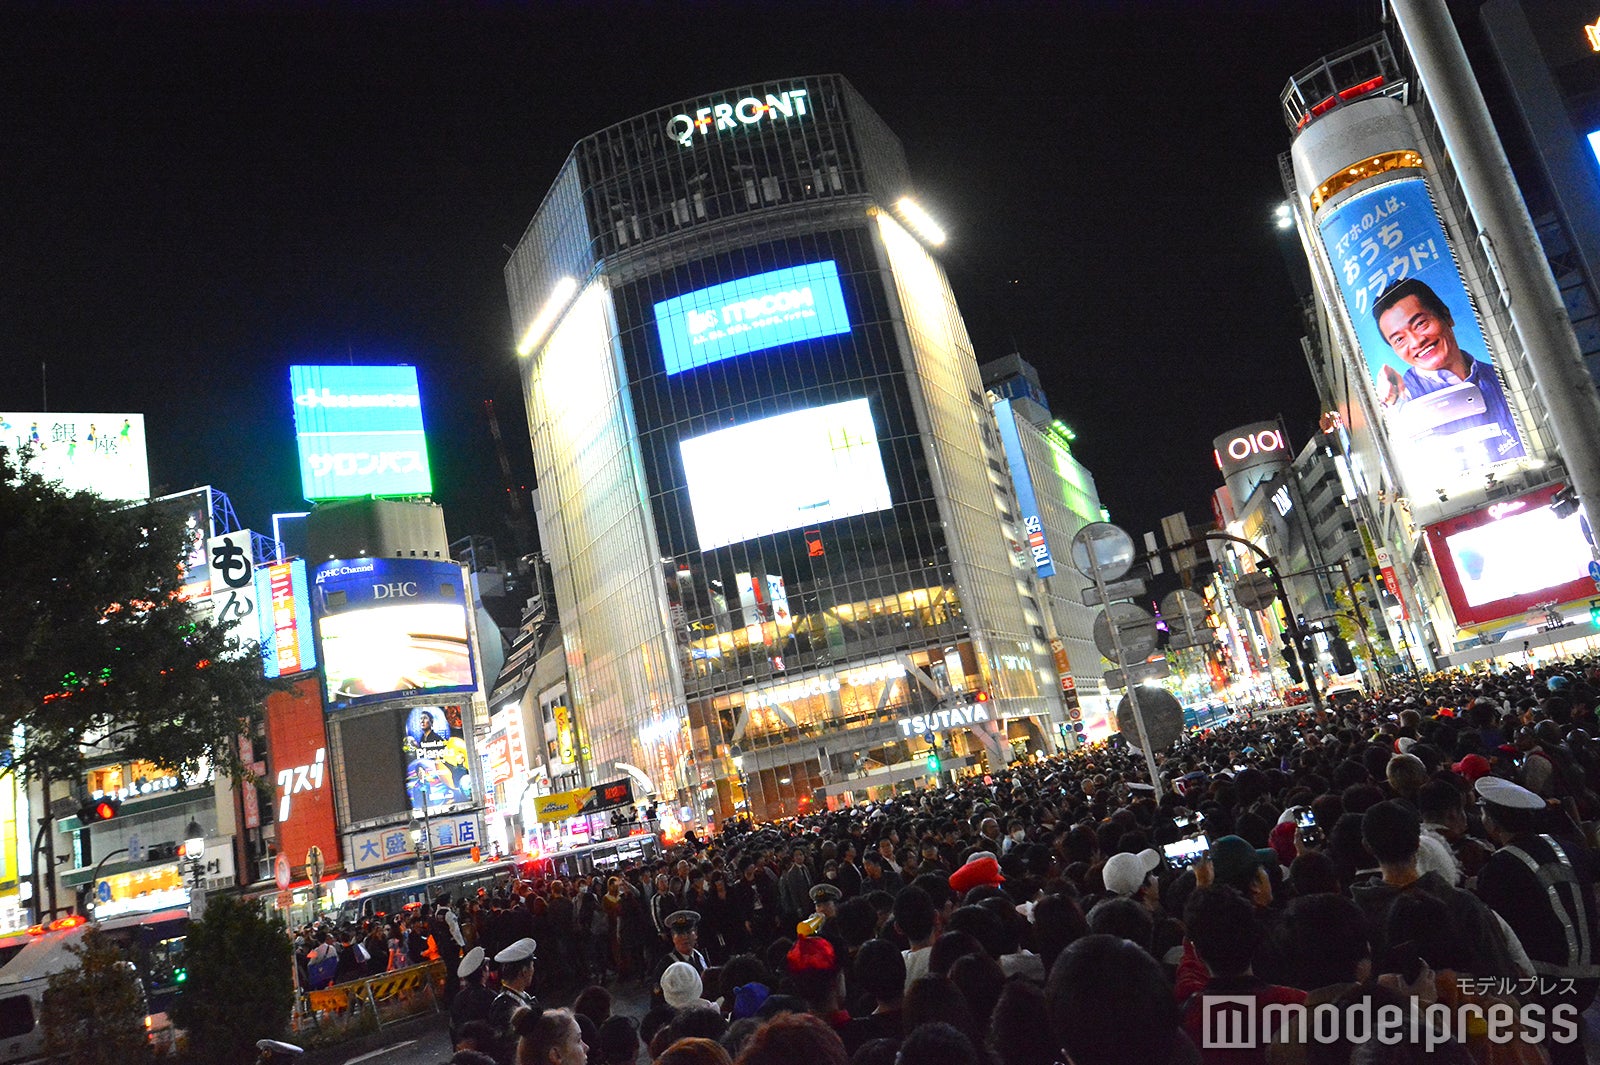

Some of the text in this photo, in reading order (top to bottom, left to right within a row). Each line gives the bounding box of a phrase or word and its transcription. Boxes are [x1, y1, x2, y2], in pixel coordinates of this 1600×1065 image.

[666, 89, 807, 147] QFRONT
[1335, 196, 1406, 259] スマホの人は、
[1343, 222, 1403, 286] おうち
[308, 450, 424, 477] サロンパス
[1024, 515, 1050, 567] SEIBU
[340, 564, 374, 574] Channel
[373, 582, 417, 599] DHC
[898, 703, 988, 736] TSUTAYA
[360, 820, 475, 862] 大盛書店
